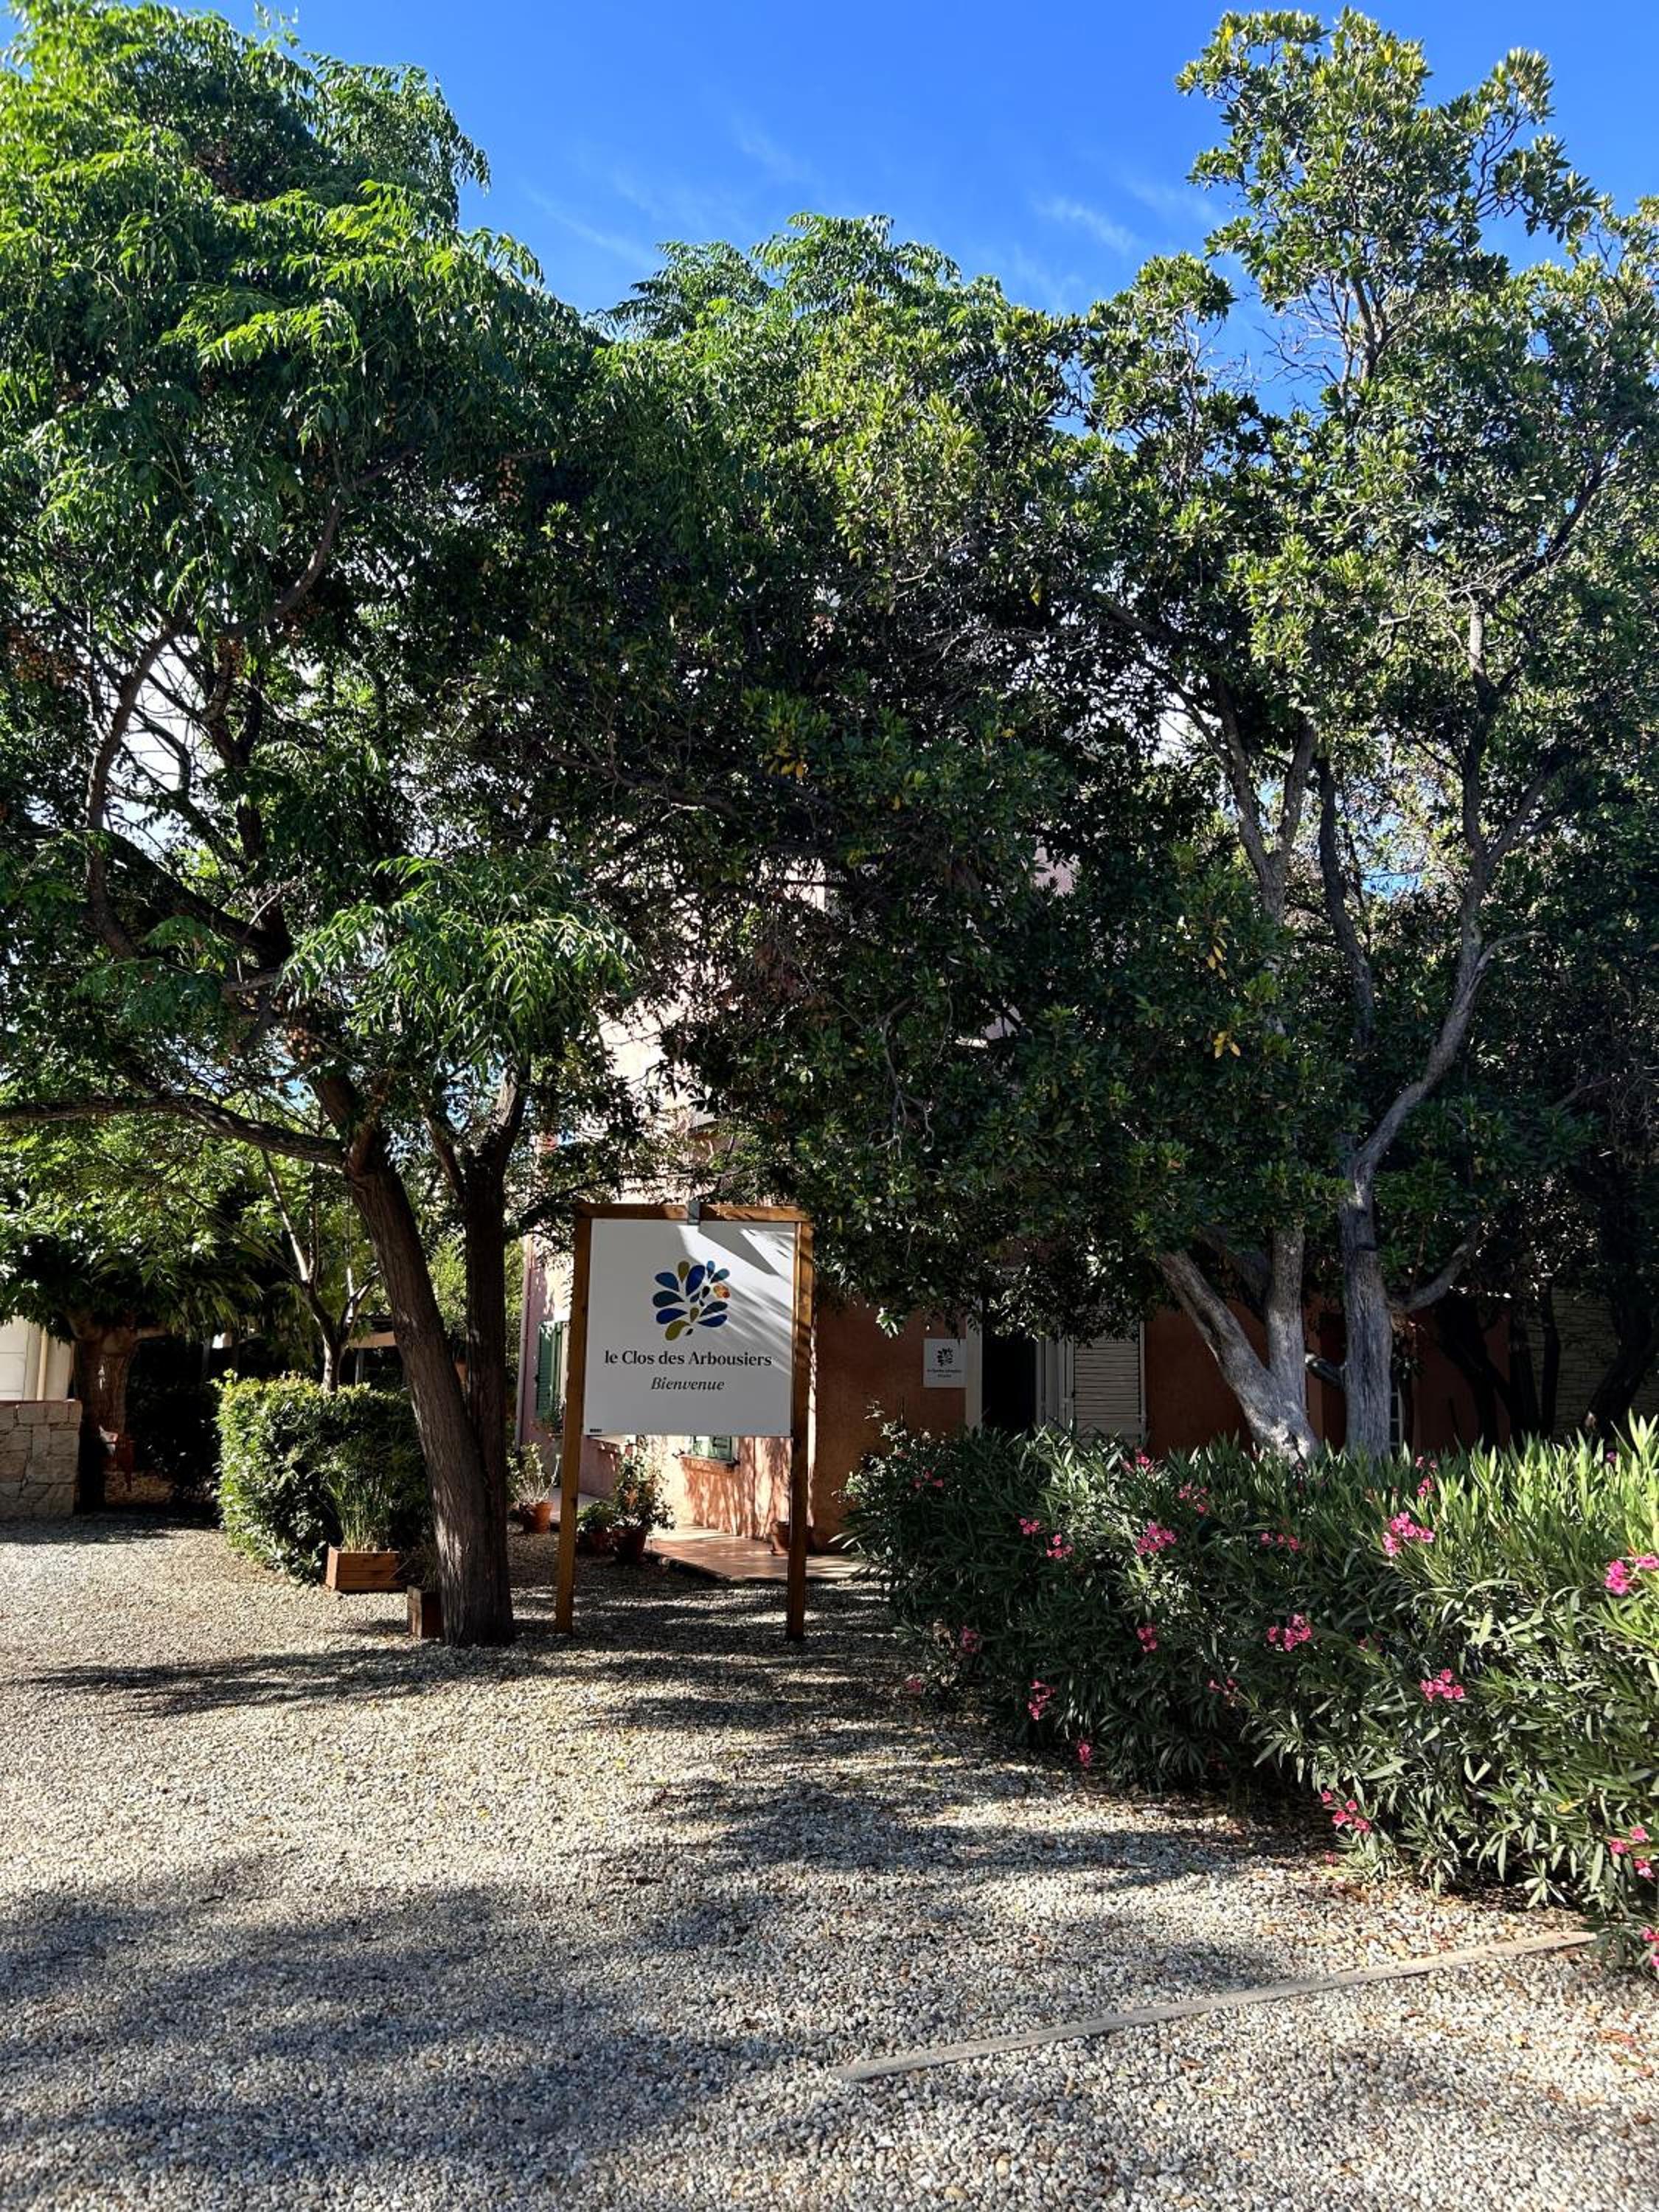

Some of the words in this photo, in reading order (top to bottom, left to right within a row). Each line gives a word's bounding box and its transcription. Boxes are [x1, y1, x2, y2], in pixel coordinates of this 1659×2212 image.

[605, 1350, 618, 1364] le
[622, 1350, 655, 1365] Clos
[658, 1351, 685, 1365] des
[689, 1352, 772, 1366] Arbousiers
[651, 1377, 725, 1391] Bienvenue
